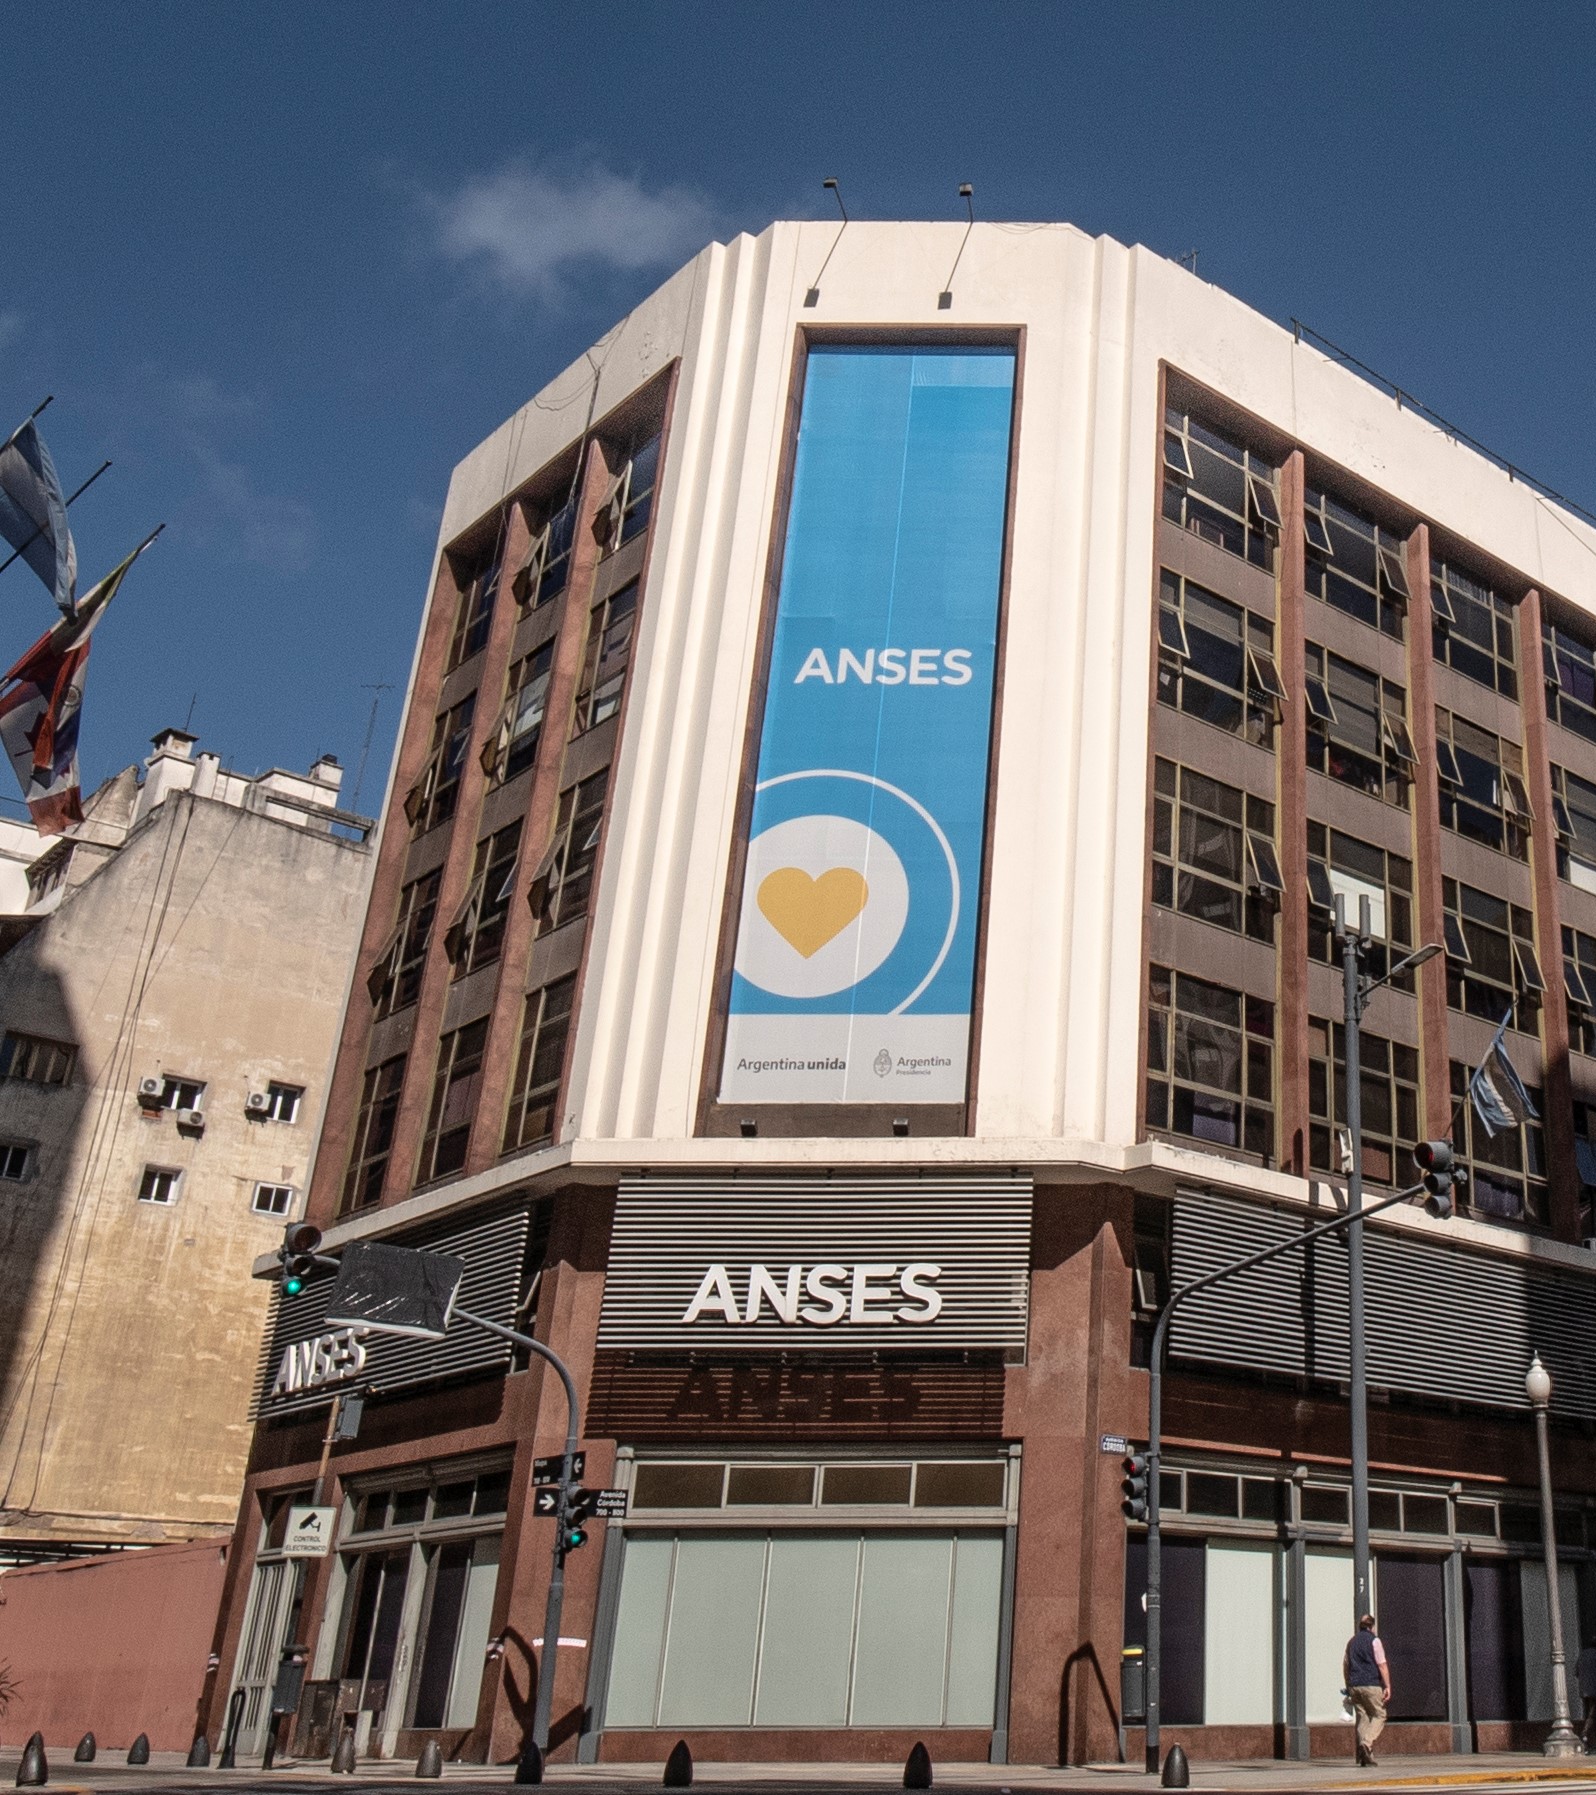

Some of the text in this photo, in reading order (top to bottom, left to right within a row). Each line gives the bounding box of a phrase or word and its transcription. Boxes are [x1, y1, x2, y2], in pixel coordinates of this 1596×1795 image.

[793, 647, 973, 686] ANSES
[737, 1057, 846, 1073] Argentina unida
[896, 1056, 952, 1069] Argentina
[681, 1263, 943, 1325] ANSES
[271, 1327, 370, 1398] ANSES
[293, 1535, 321, 1543] CONTROL
